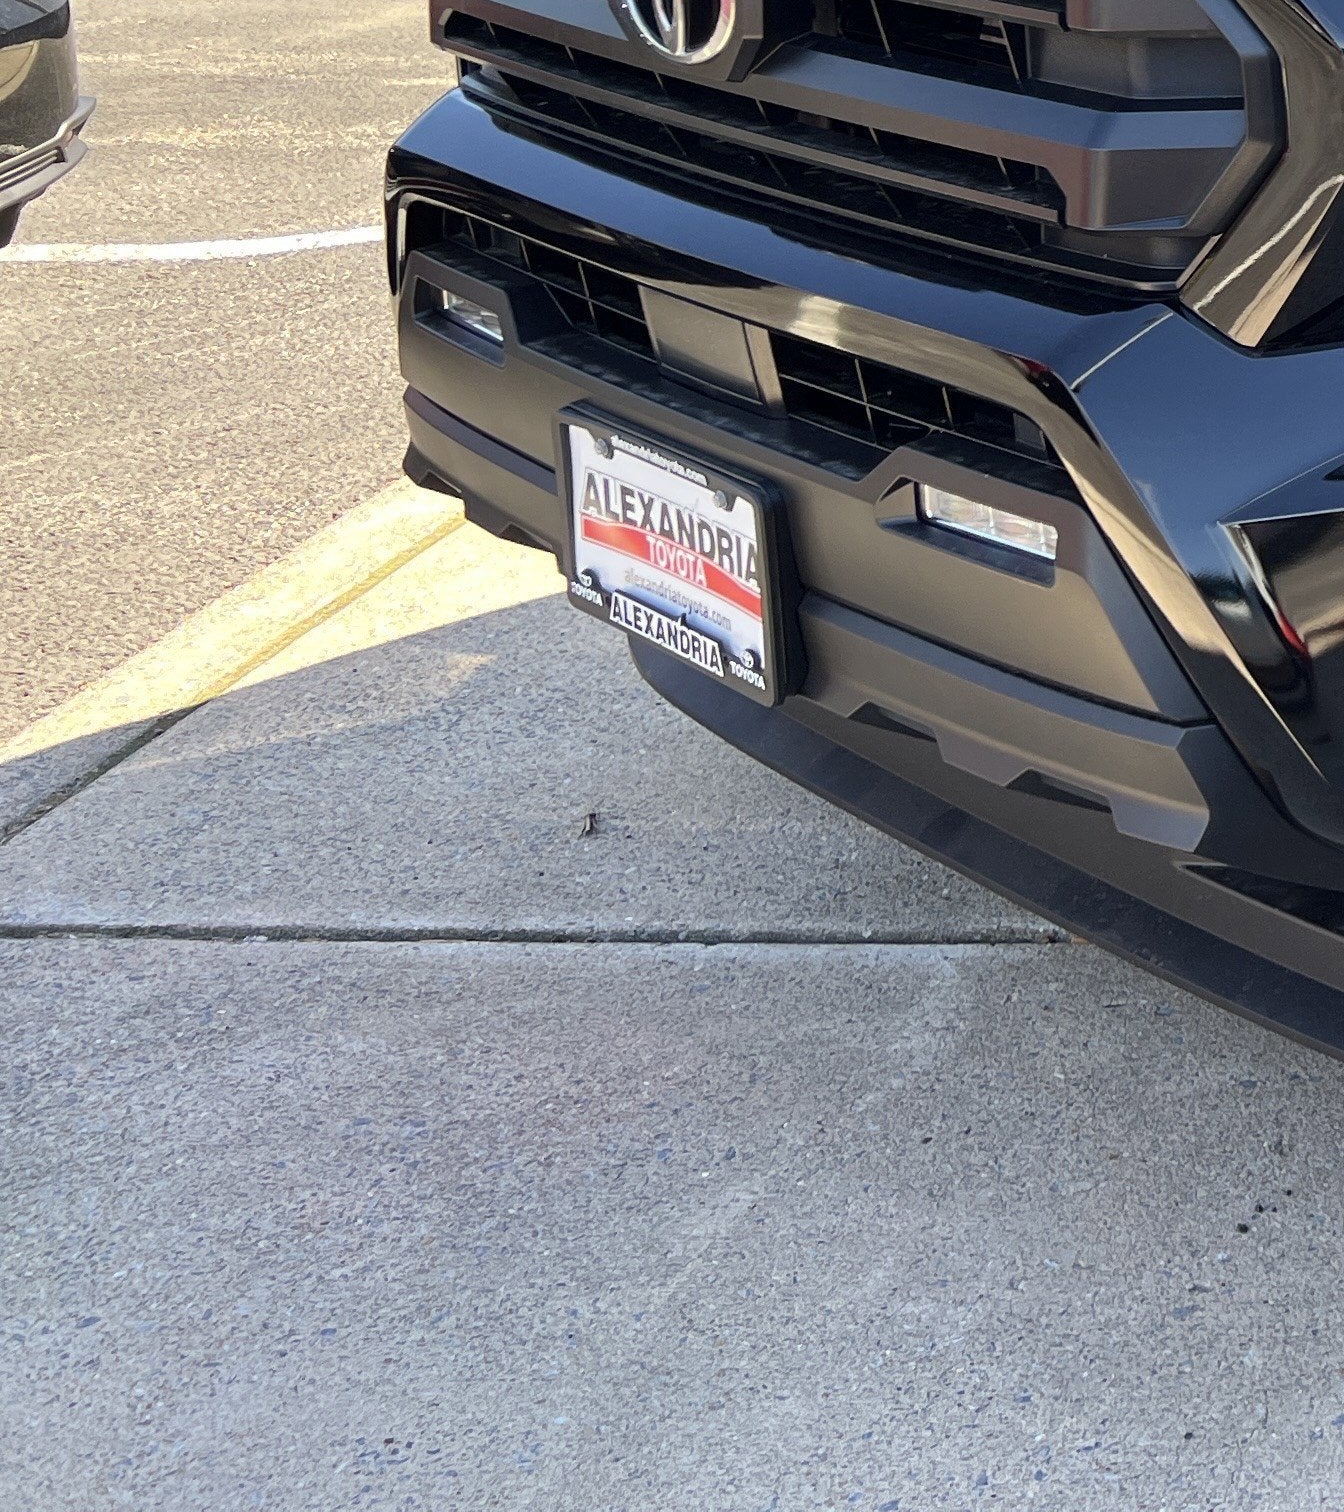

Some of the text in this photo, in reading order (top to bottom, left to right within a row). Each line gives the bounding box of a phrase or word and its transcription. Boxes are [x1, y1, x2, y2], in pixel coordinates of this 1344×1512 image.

[583, 471, 758, 582] ALEXANDRIA
[646, 534, 708, 587] TOYOTA
[624, 566, 733, 632] alexandriatoyota.com
[612, 595, 721, 674] ALEXANDRIA
[729, 660, 766, 691] TOYOTA
